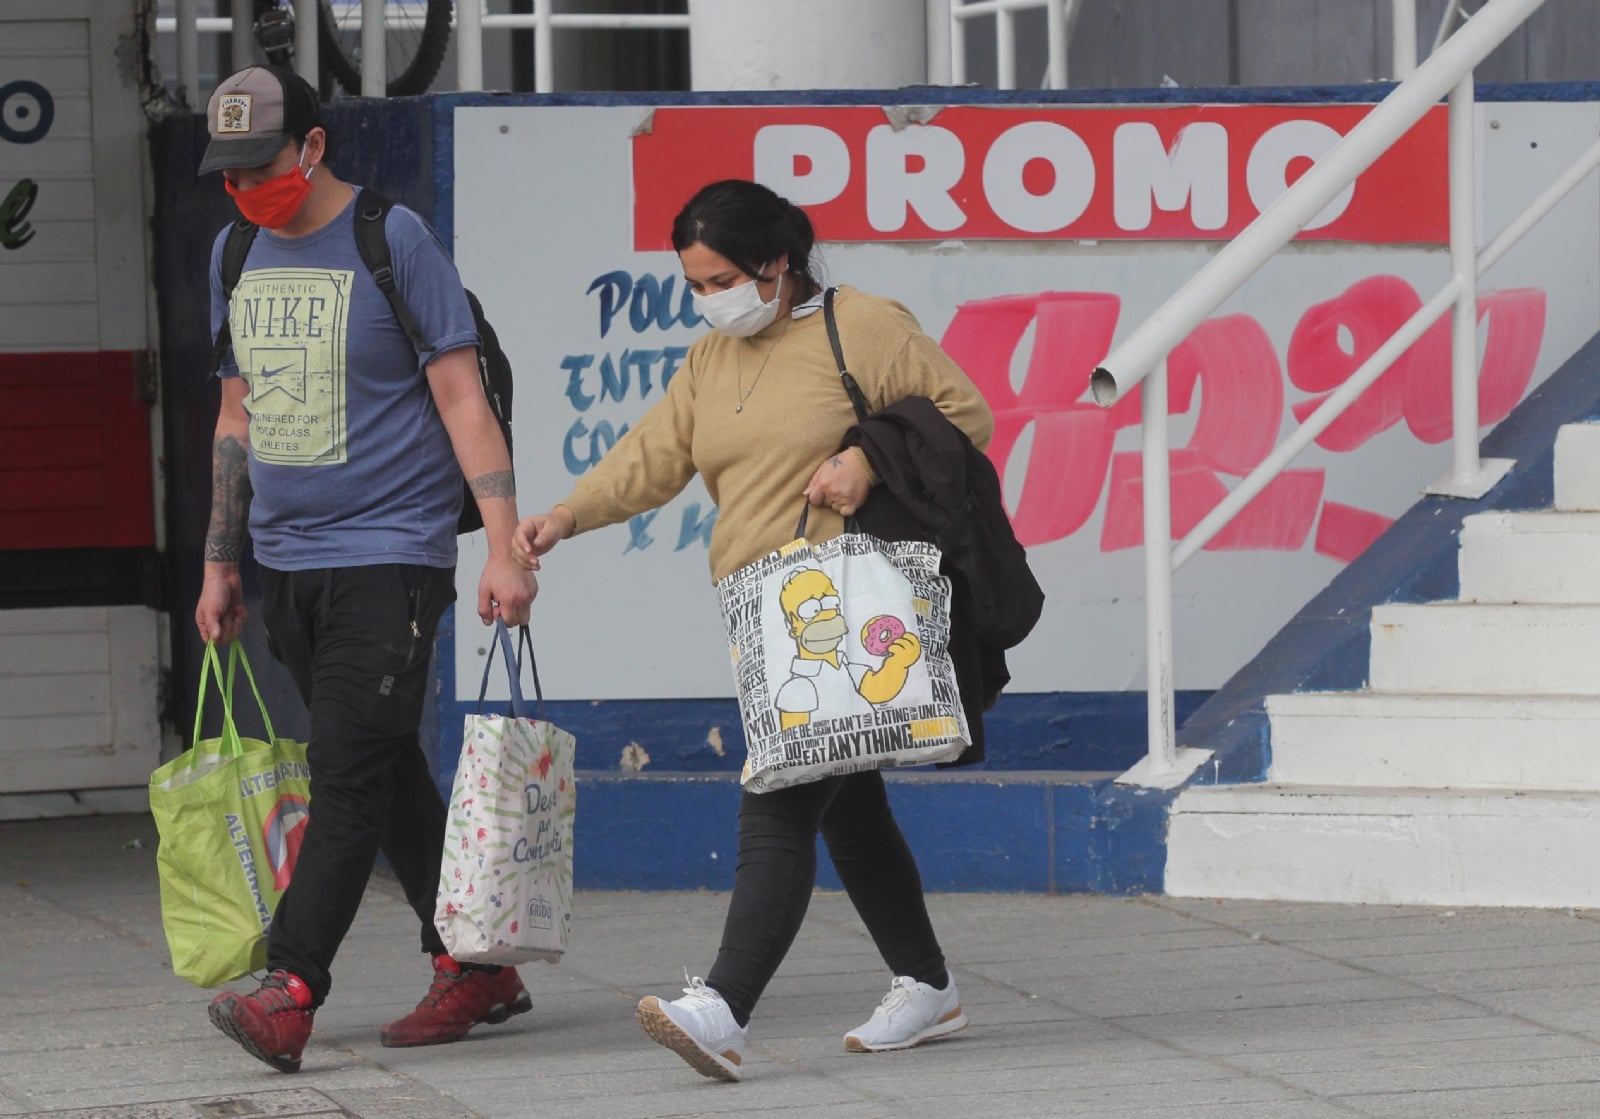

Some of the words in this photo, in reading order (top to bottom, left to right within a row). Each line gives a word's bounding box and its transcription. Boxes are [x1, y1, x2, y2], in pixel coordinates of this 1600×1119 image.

[754, 119, 1356, 232] PROMO
[253, 284, 317, 295] AUTHENTIC
[241, 297, 326, 339] NIKE
[297, 414, 319, 425] FOR
[278, 427, 311, 438] CLASS
[841, 542, 872, 557] FRESH
[831, 714, 862, 734] CAN'T
[874, 707, 910, 726] EATING
[918, 703, 955, 720] UNLESS
[802, 747, 826, 766] EAT
[828, 723, 914, 762] ANYTHING
[529, 902, 552, 920] GRIDO
